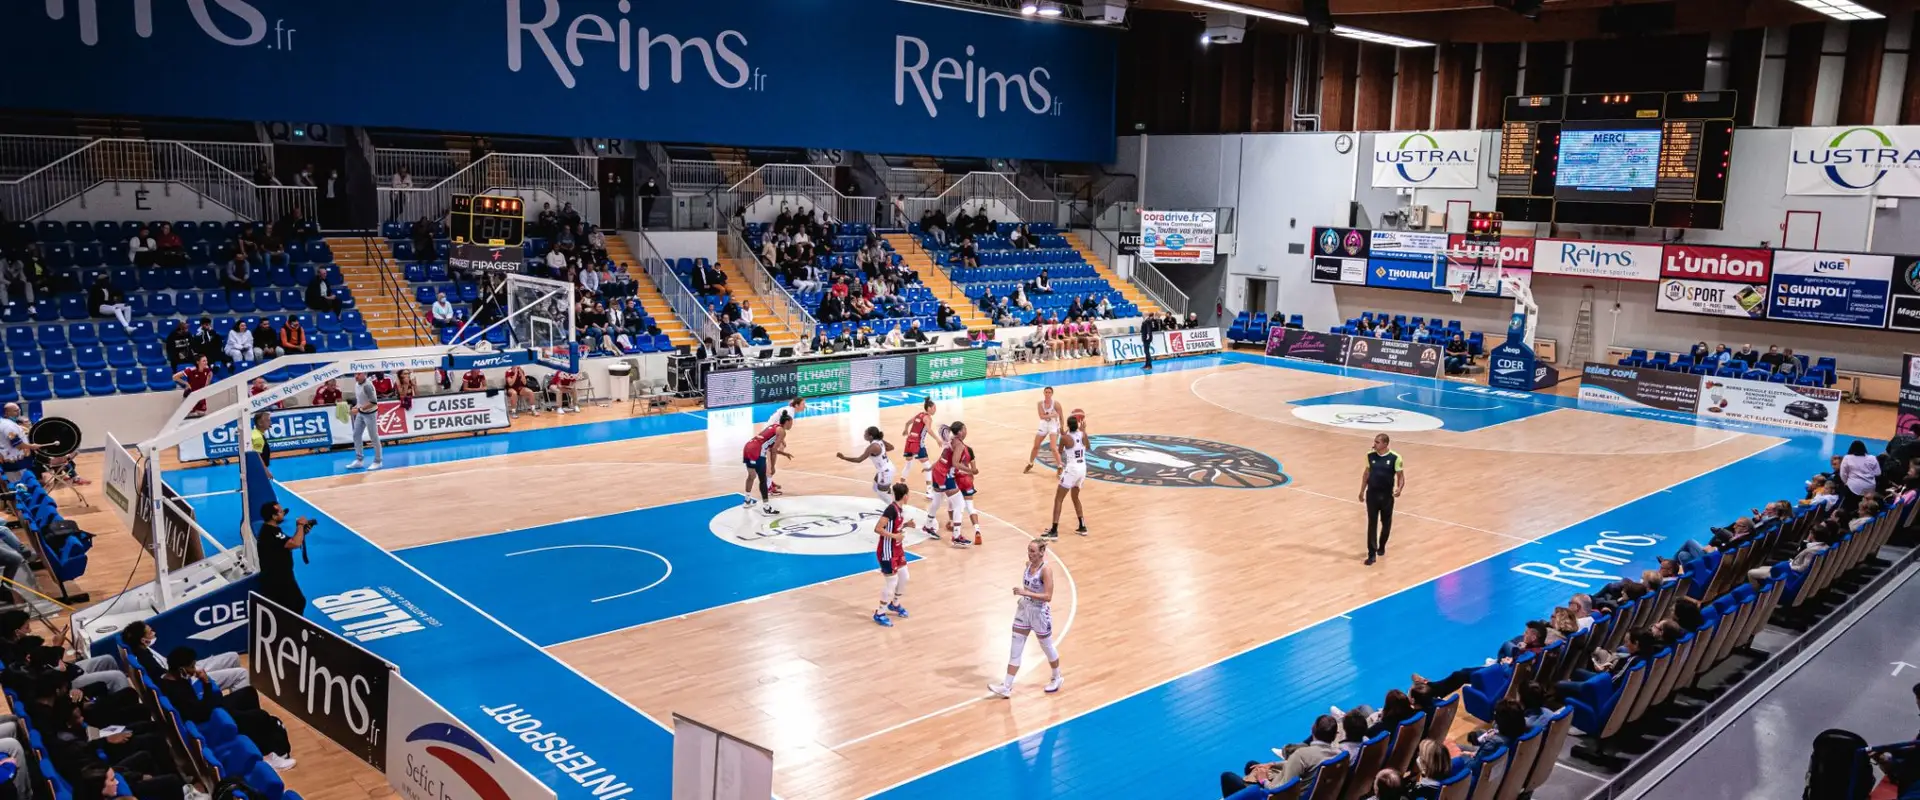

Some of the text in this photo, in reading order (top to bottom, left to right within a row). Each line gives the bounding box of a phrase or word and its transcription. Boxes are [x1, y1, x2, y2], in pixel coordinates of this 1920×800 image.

[1376, 150, 1475, 163] LUSTRAL
[136, 190, 152, 210] E
[1144, 213, 1199, 222] coradrive.fr
[472, 260, 521, 271] FIPAGEST
[1667, 250, 1764, 277] L'union
[1819, 261, 1845, 270] NGE
[1388, 268, 1435, 279] THOURAU
[1670, 284, 1680, 292] IN
[1687, 287, 1726, 302] SPORT
[1789, 284, 1847, 298] GUINTOLI
[1787, 297, 1821, 309] EHTP
[1190, 331, 1208, 339] CAISSE
[1186, 341, 1216, 350] D'EPARGNE
[1503, 346, 1521, 354] Jeep
[350, 358, 435, 371] Reims Reims Reims
[1497, 359, 1524, 369] CDER
[754, 373, 786, 385] SALON
[789, 372, 802, 383] DE
[251, 367, 339, 408] Reims Reims Reims
[769, 387, 782, 397] AU
[785, 386, 797, 395] 10
[800, 383, 818, 393] OCT
[428, 397, 475, 412] CAISSE
[413, 413, 492, 431] D'EPARGNE
[210, 447, 234, 455] ALSACE
[301, 437, 329, 445] LORRAINE
[194, 600, 250, 626] CDE
[480, 703, 634, 800] INTERSPORT
[405, 753, 435, 797] Sefic
